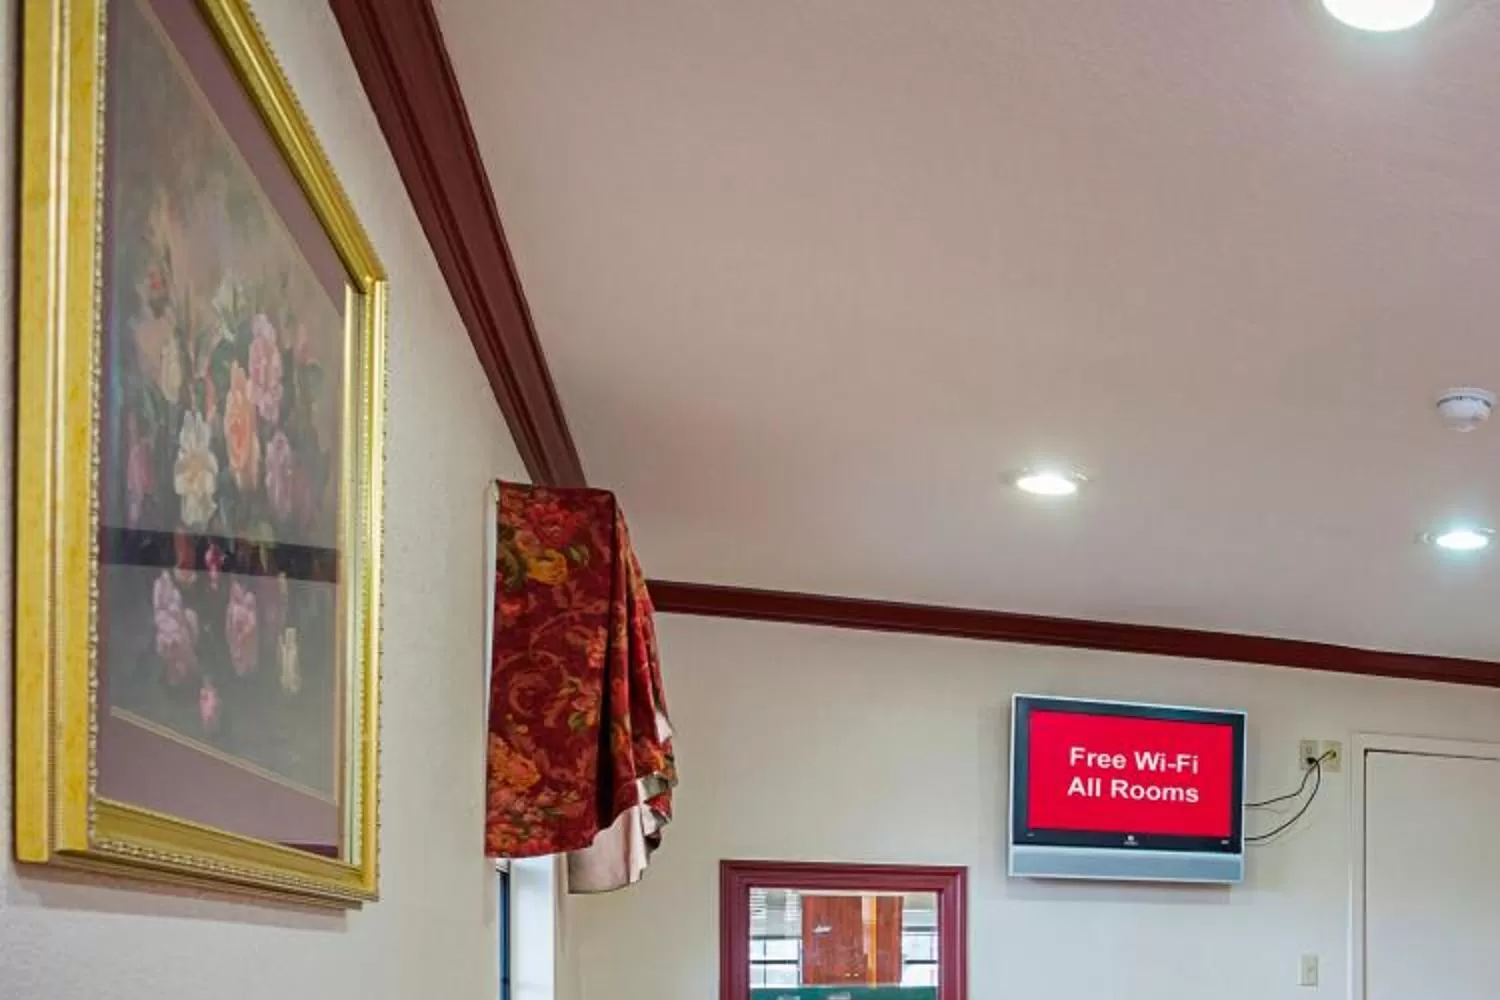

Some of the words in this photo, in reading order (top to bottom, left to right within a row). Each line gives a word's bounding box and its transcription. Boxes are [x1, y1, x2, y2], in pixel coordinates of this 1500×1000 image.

[1070, 746, 1127, 769] Free
[1134, 751, 1199, 774] Wi-Fi
[1067, 776, 1102, 797] All
[1111, 778, 1199, 803] Rooms
